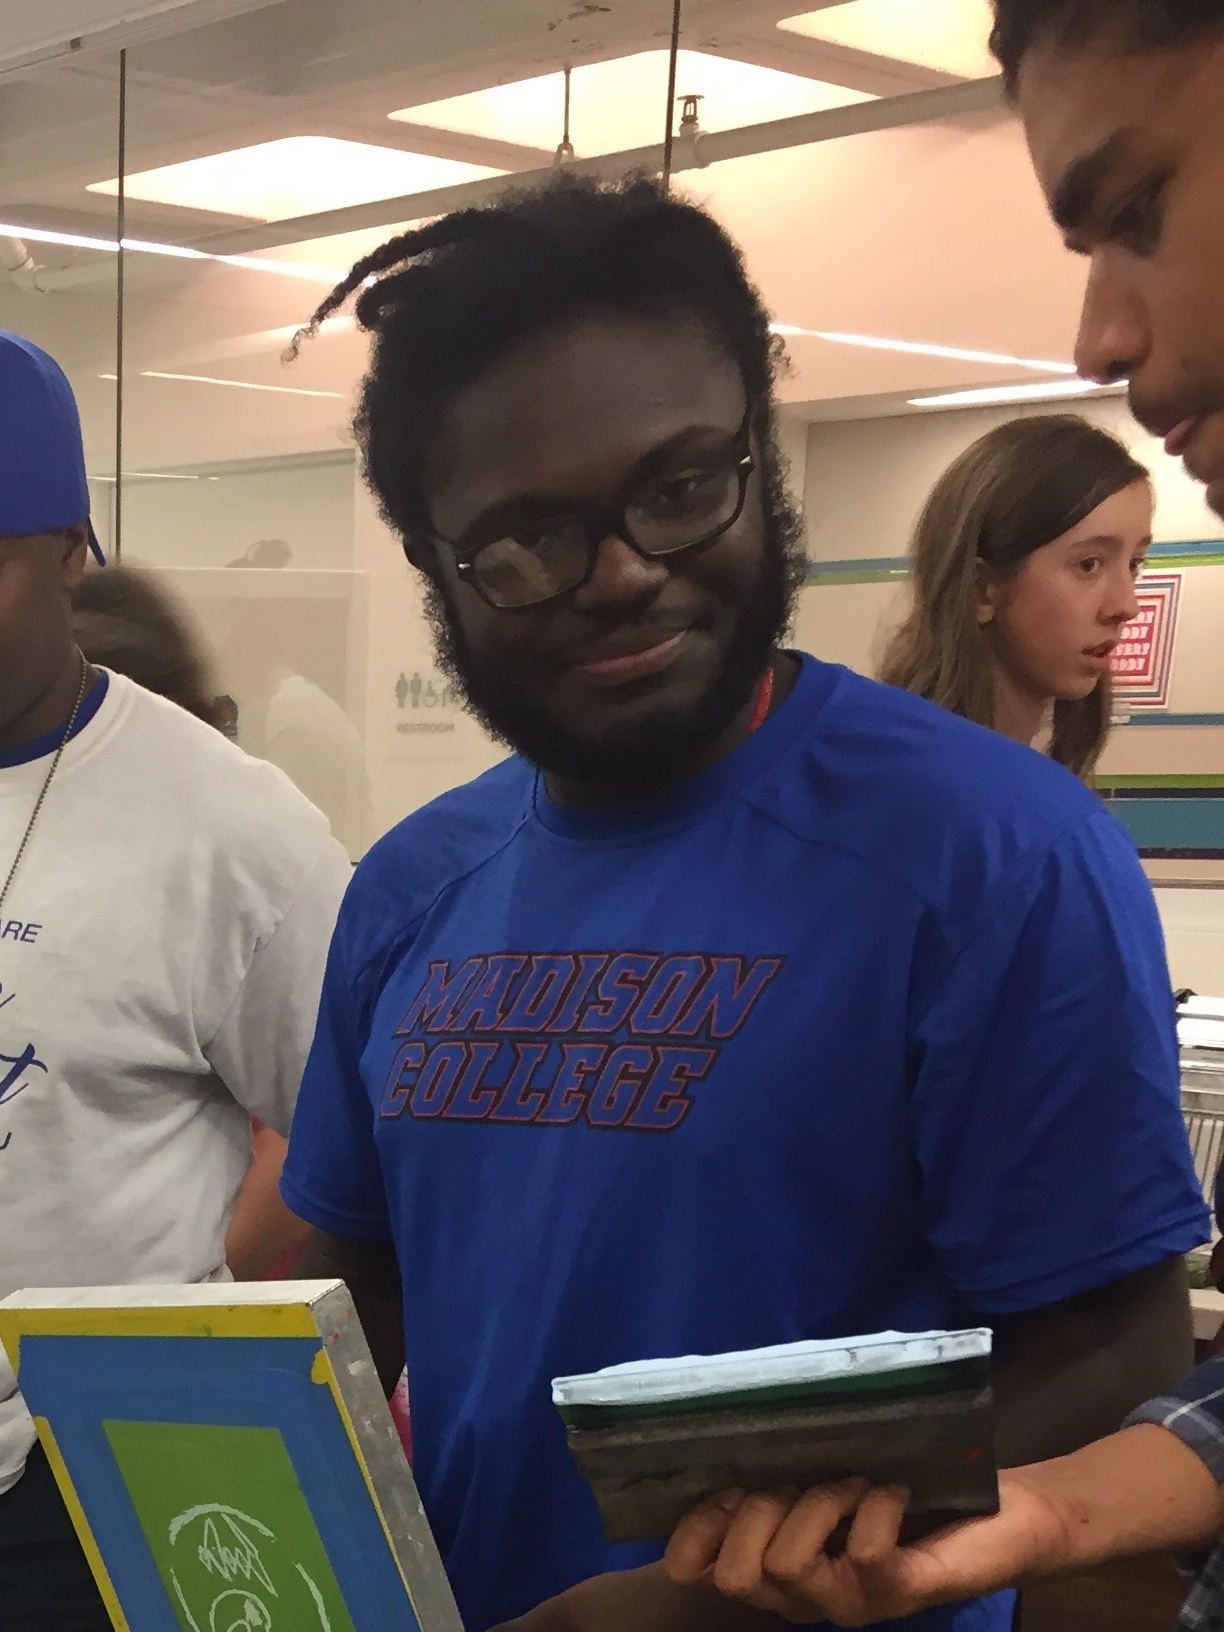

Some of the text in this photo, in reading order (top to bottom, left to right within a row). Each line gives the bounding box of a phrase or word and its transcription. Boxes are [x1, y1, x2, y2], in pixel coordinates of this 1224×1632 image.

[396, 722, 455, 734] RESTROOM
[391, 949, 788, 1042] MADISON
[378, 1039, 724, 1134] COLLEGE
